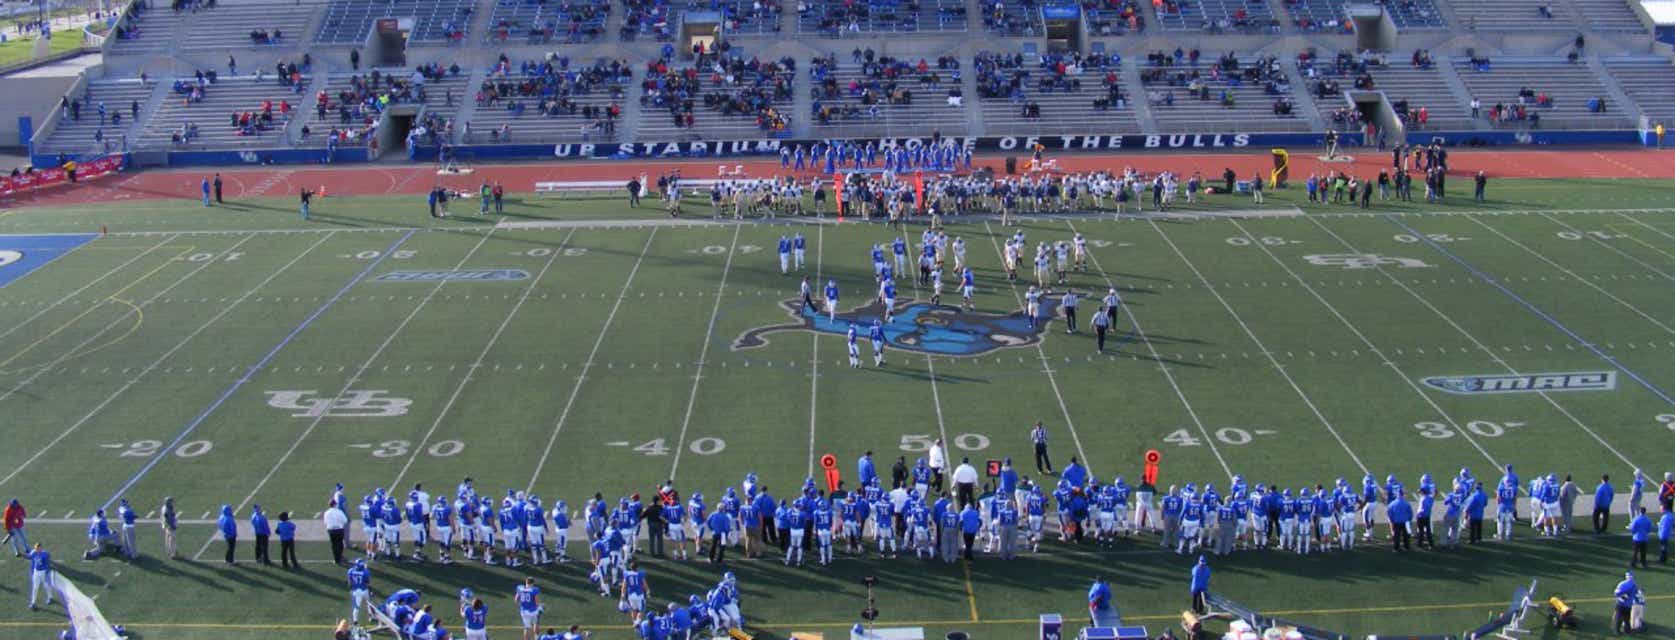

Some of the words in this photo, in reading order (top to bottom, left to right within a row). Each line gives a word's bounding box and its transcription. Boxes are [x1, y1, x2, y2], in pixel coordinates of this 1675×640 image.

[618, 139, 781, 157] STADIUM
[1000, 136, 1041, 149] OF
[1061, 135, 1123, 149] THE
[1144, 133, 1250, 148] BULLS
[1481, 371, 1617, 392] MAC
[1163, 427, 1253, 446] 40
[1413, 421, 1505, 439] 30
[120, 440, 213, 457] 20
[372, 440, 465, 457] 30
[634, 437, 727, 456] 40
[899, 434, 991, 453] 50
[988, 461, 1000, 475] 3
